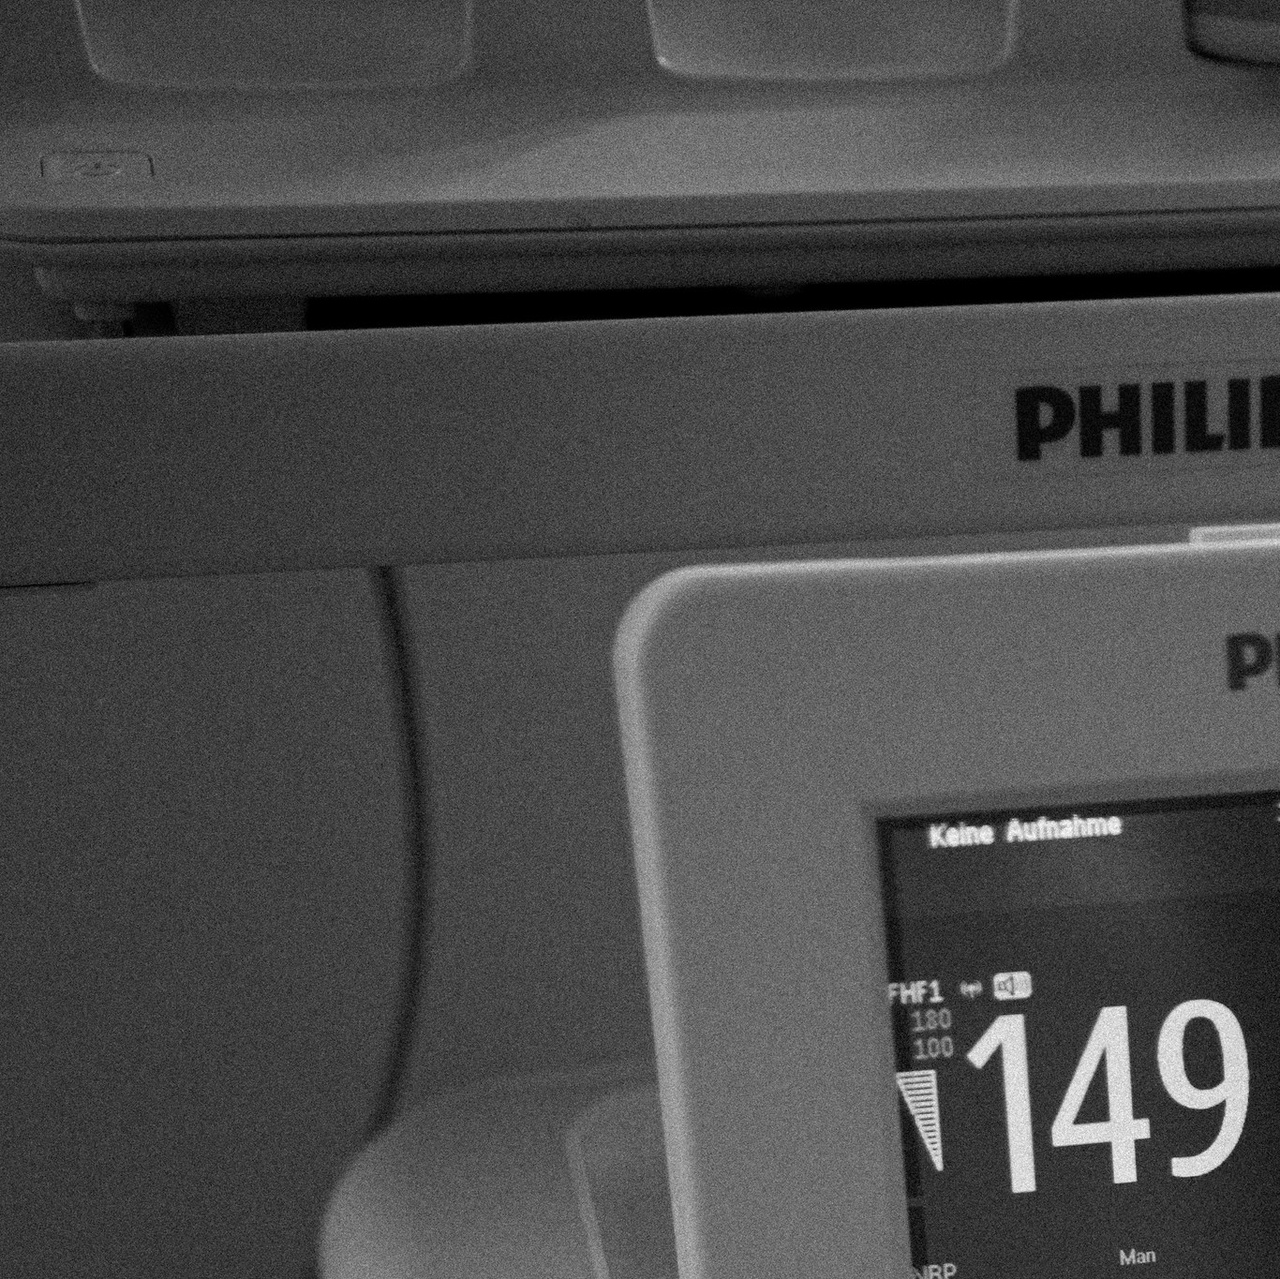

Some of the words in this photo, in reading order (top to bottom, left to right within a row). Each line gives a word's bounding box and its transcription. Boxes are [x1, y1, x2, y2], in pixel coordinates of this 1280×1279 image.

[929, 824, 994, 848] Keine
[1006, 815, 1122, 843] Aufnahme
[888, 980, 944, 1004] FHF1
[911, 1009, 952, 1033] 180
[914, 1036, 954, 1060] 100
[966, 999, 1250, 1194] 149
[1119, 1247, 1156, 1267] Man
